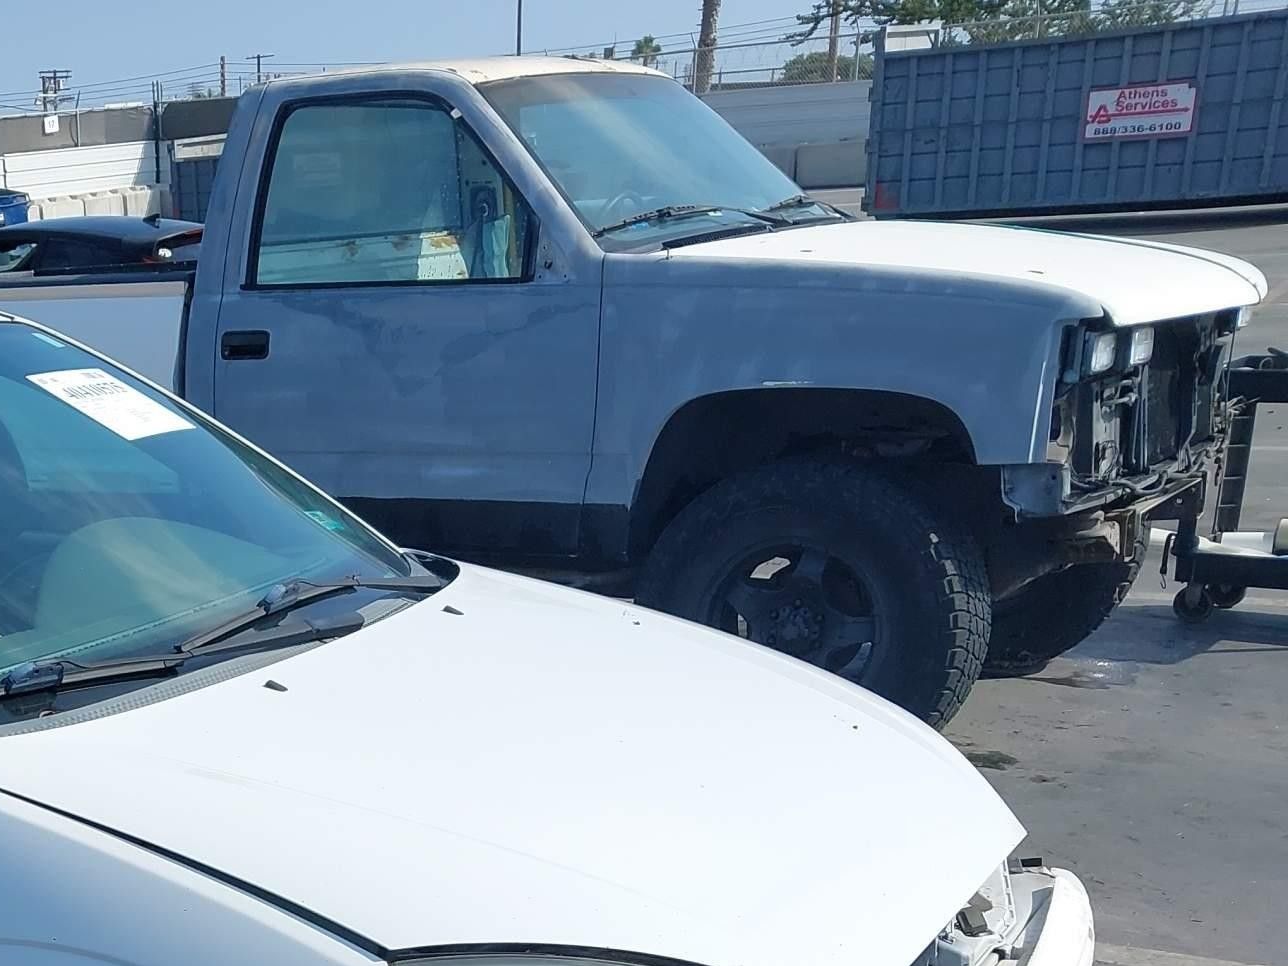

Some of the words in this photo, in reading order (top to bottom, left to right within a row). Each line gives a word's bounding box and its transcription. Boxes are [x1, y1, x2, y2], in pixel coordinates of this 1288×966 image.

[1117, 89, 1169, 101] Athens
[1115, 99, 1179, 112] Services
[1093, 122, 1182, 135] 888/336-6100
